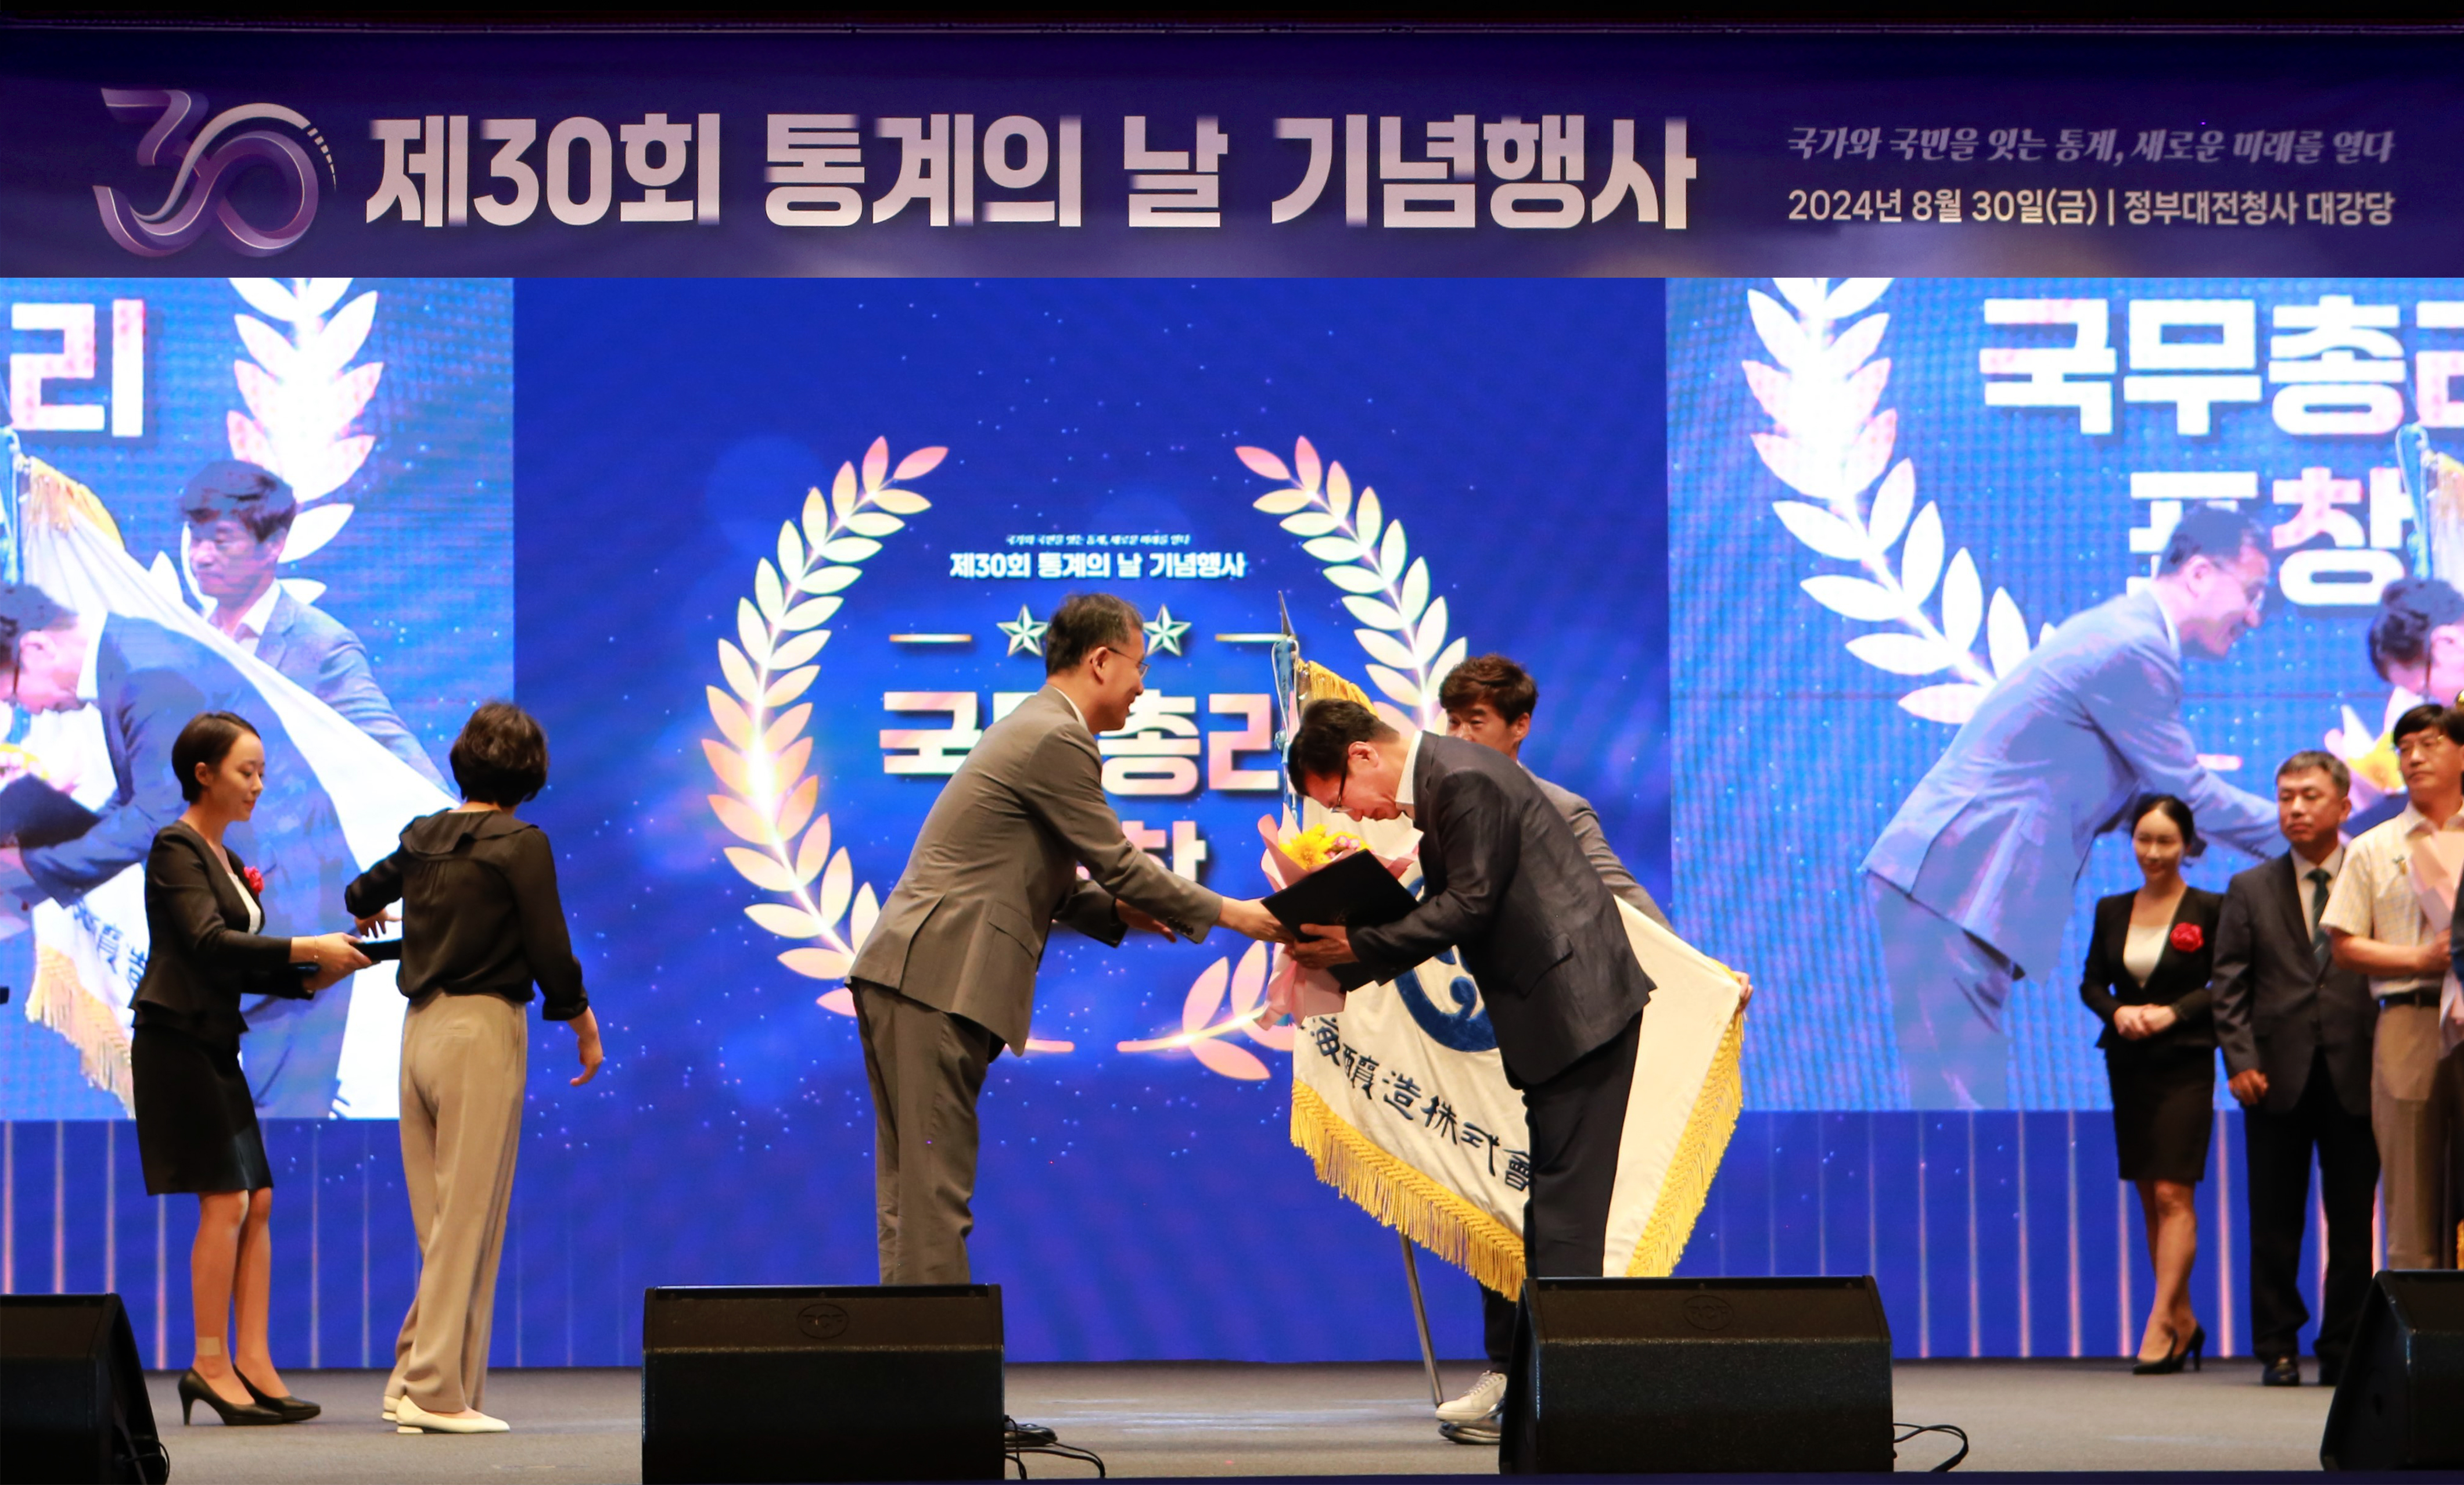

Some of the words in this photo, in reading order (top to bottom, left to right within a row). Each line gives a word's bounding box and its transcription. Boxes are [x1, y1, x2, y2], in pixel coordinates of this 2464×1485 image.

[366, 113, 720, 227] 제30회
[765, 113, 1082, 227] 통계의
[1123, 115, 1228, 227] 날
[1271, 114, 1697, 229] 기념행사
[1788, 127, 1881, 160] 국가와
[1890, 128, 1978, 161] 국민을
[1988, 128, 2046, 162] 잇는
[2056, 129, 2124, 166] 통계,
[2133, 129, 2224, 164] 새로운
[2233, 131, 2322, 164] 미래를
[2334, 131, 2393, 164] 열다
[1788, 189, 1902, 223] 2024년
[1912, 189, 1962, 223] 8월
[1972, 189, 2097, 225] 30일(금)
[2124, 191, 2298, 225] 정부대전청사
[2307, 192, 2394, 225] 대강당
[950, 552, 1031, 578] 제30회
[1038, 552, 1111, 578] 통계의
[1117, 552, 1143, 578] 날
[1150, 552, 1247, 578] 기념행사
[879, 686, 1301, 796] 국총리
[1301, 1016, 1530, 1192] 海釀造株式會
